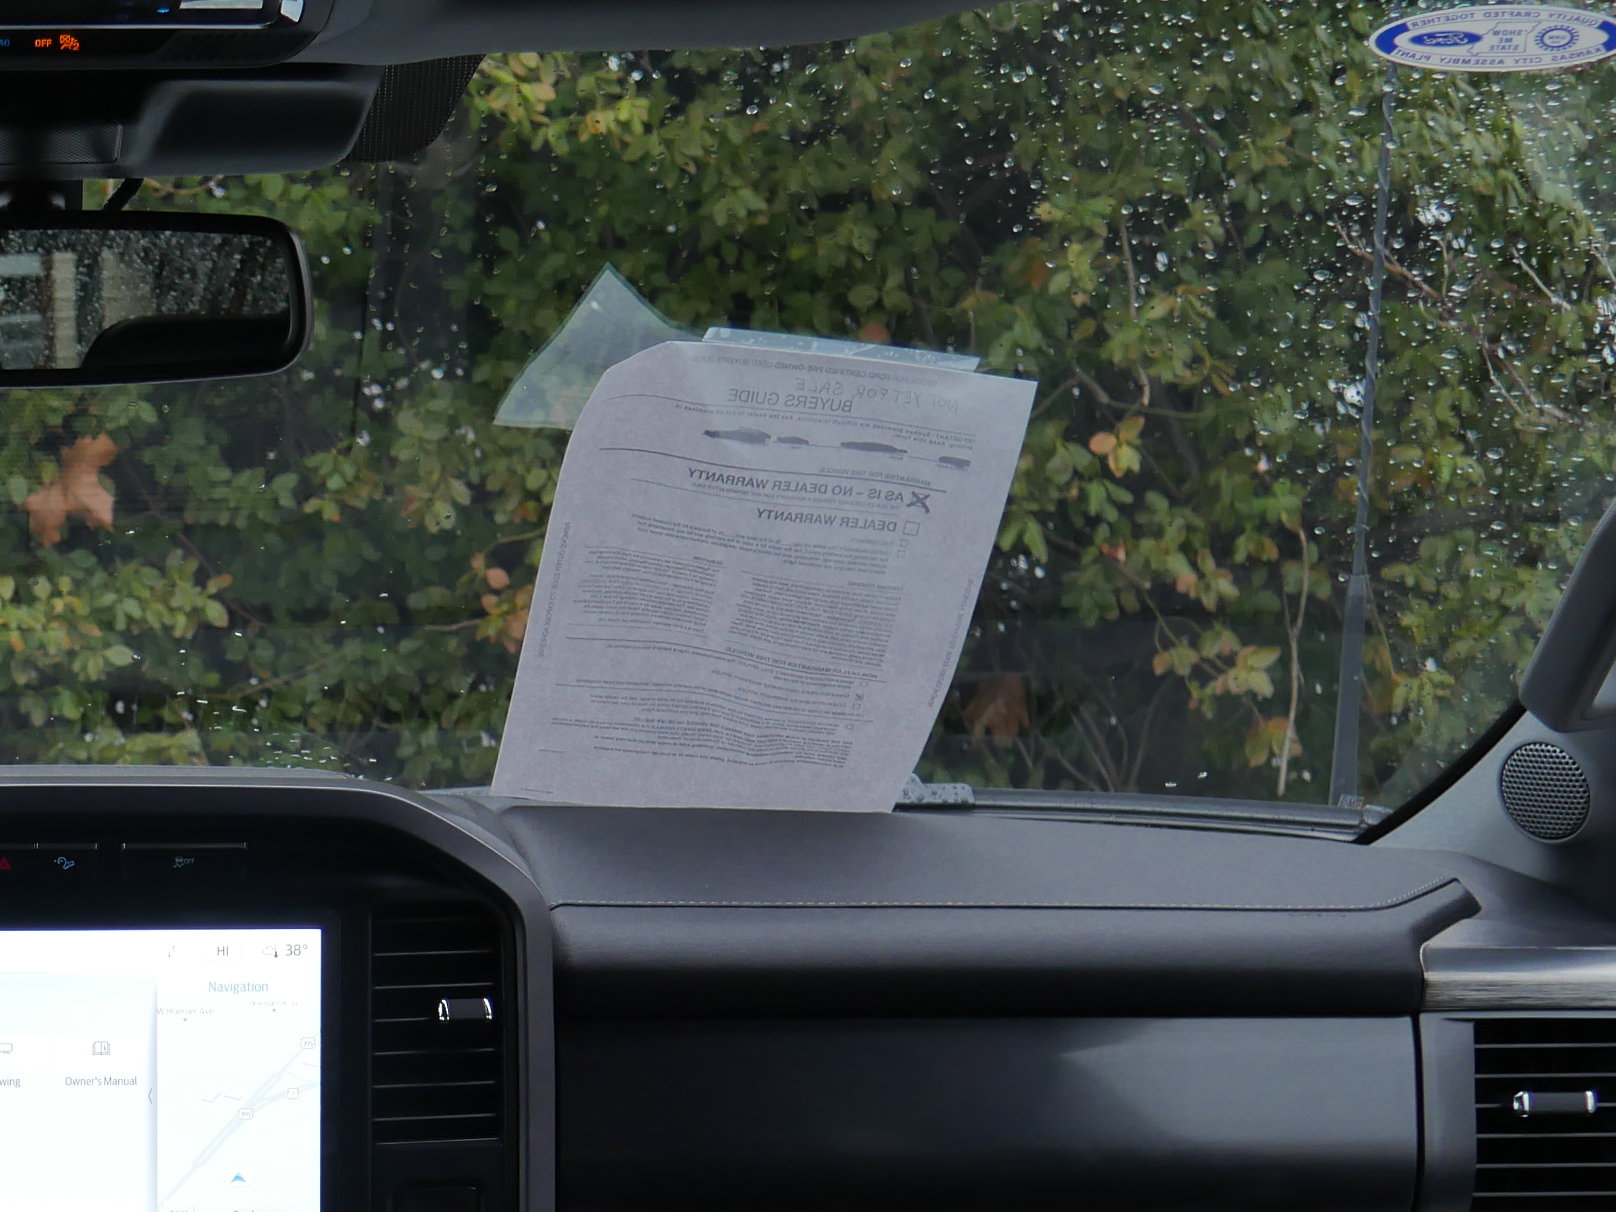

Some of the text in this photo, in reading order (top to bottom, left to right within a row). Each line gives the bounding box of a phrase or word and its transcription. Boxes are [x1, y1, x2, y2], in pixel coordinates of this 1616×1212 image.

[34, 39, 52, 48] OFF
[217, 945, 229, 957] HI
[285, 943, 308, 957] 38°
[208, 981, 269, 995] Navigation
[64, 1075, 138, 1087] Owner's Manual
